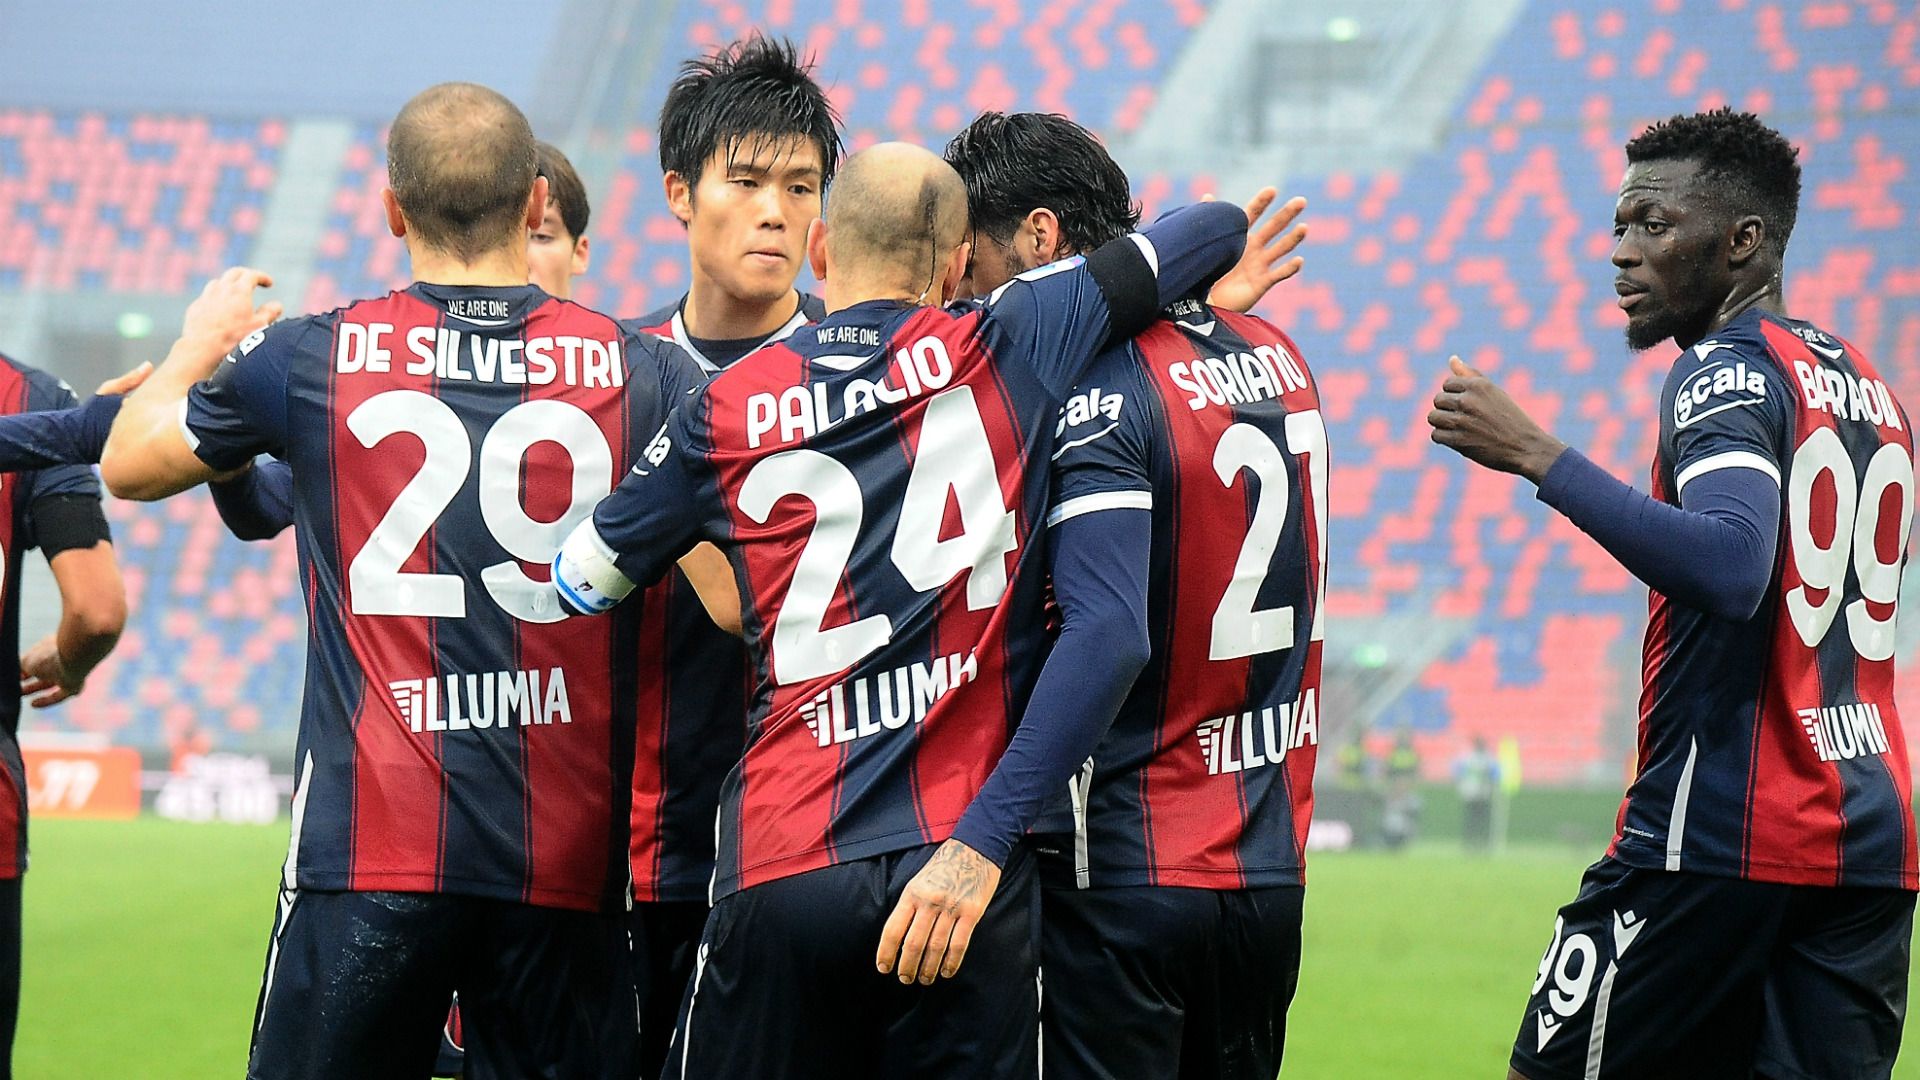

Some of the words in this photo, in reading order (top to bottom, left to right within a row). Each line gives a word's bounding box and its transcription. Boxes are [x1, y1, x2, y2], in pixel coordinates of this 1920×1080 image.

[447, 300, 466, 316] WE
[467, 300, 487, 317] ARE
[488, 301, 509, 318] ONE
[817, 328, 835, 345] WE
[836, 326, 858, 344] ARE
[859, 328, 880, 346] ONE
[336, 322, 395, 374] DE
[405, 326, 625, 389] SILVESTRI
[1168, 343, 1308, 411] SORIANO
[746, 335, 953, 449] PALACIO
[1055, 387, 1124, 439] ala
[1677, 362, 1766, 422] scala
[345, 390, 613, 624] 29
[736, 385, 1017, 685] 24
[1208, 408, 1328, 661] 21
[1786, 426, 1915, 662] 99
[389, 667, 573, 734] ILLUMIA
[1196, 687, 1318, 776] ILLUA
